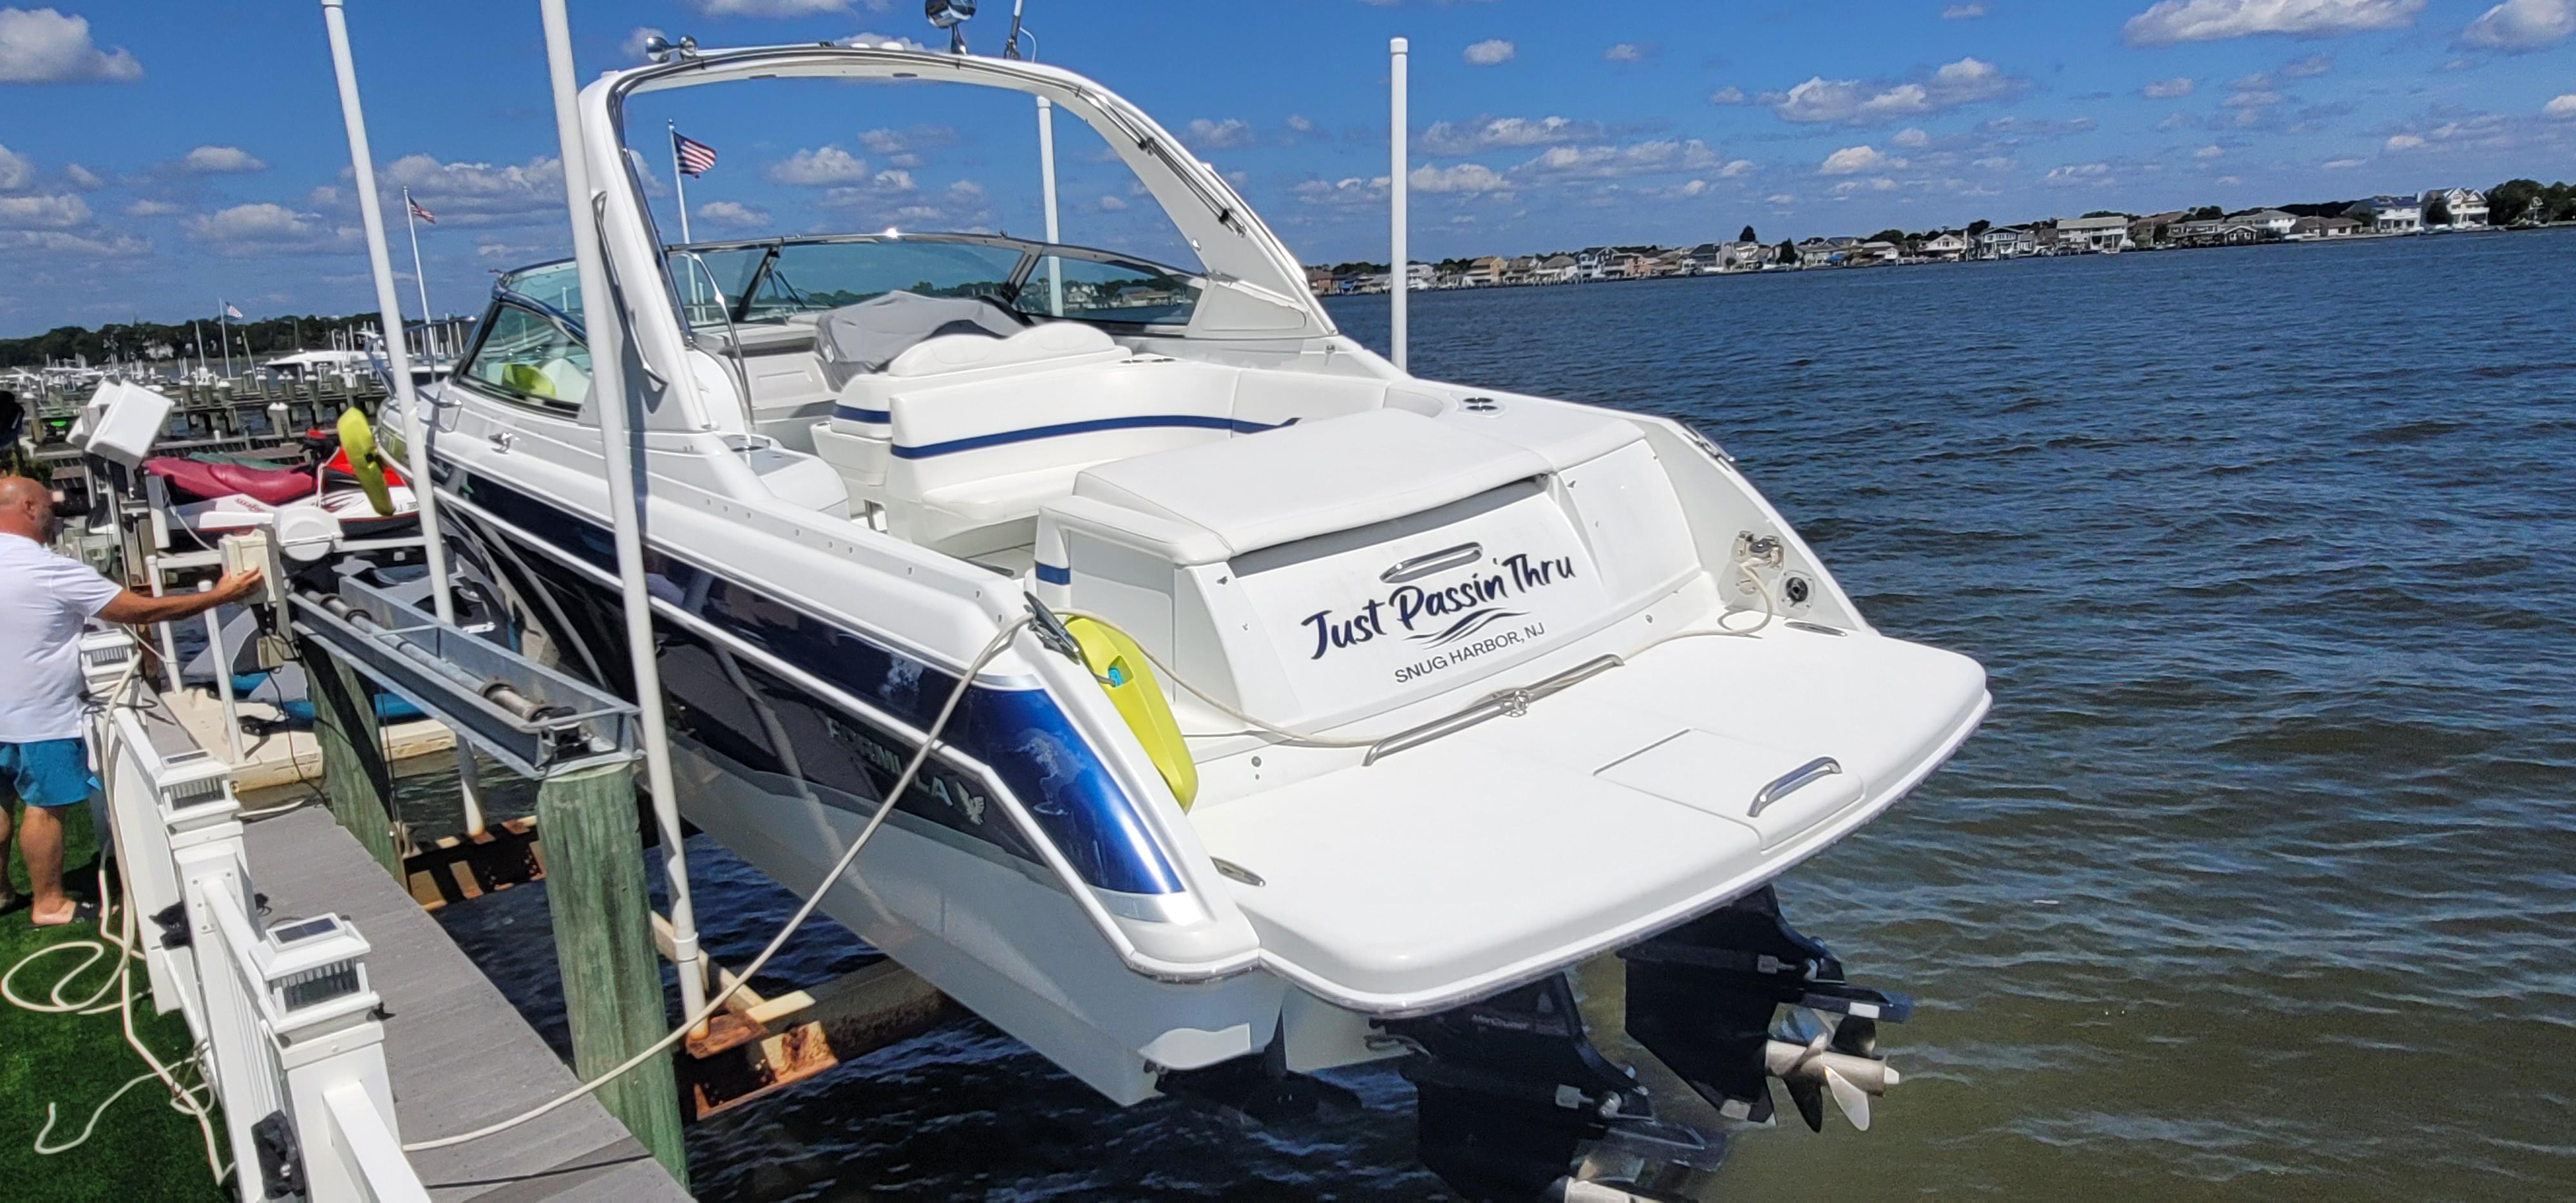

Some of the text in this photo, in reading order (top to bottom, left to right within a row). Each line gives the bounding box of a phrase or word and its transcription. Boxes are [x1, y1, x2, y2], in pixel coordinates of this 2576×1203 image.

[1300, 598, 1388, 660] Just
[1501, 553, 1577, 594] Thru
[1394, 621, 1545, 683] SNUG HARBOR, NJ
